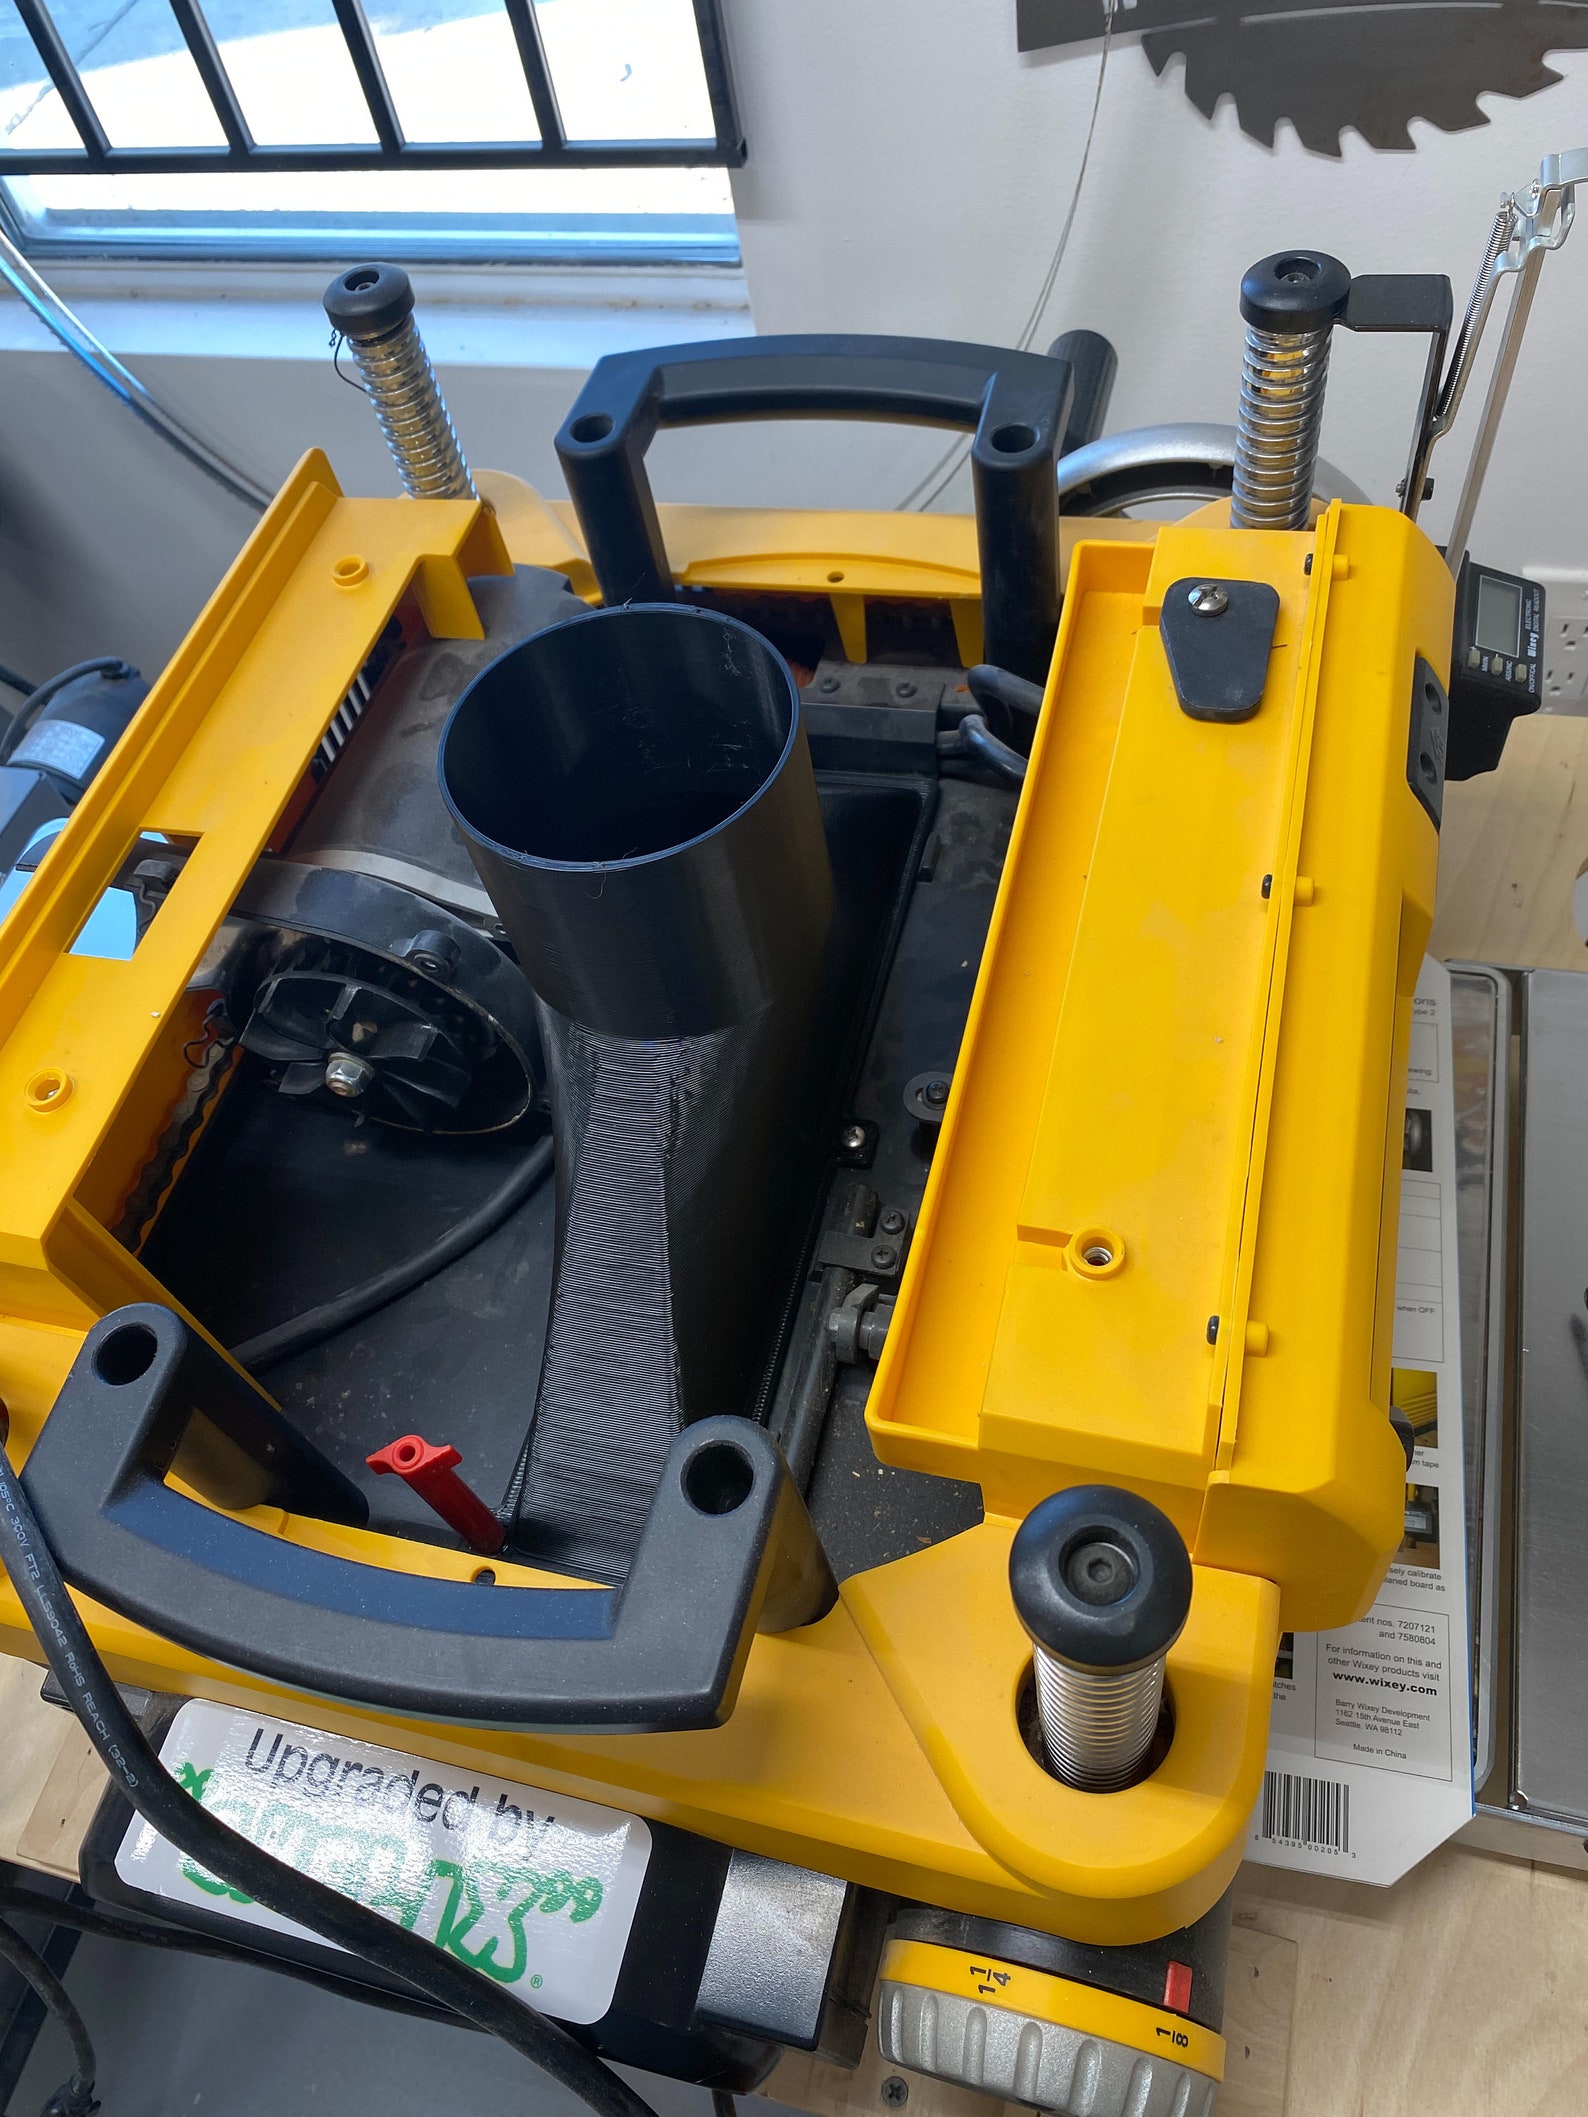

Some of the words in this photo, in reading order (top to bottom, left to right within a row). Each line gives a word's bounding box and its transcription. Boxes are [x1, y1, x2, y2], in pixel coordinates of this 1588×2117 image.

[1422, 1460, 1440, 1469] tape
[1407, 1569, 1442, 1581] calibrate
[1410, 1580, 1434, 1590] board
[1398, 1620, 1436, 1633] 7207121
[1379, 1631, 1396, 1640] and
[1398, 1632, 1436, 1645] 7580804
[25, 1553, 41, 1581] FT2
[64, 1651, 86, 1687] RoHS
[82, 1691, 110, 1741] REACH
[1325, 1643, 1340, 1653] For
[1342, 1646, 1391, 1661] information
[1393, 1655, 1405, 1663] on
[1407, 1656, 1423, 1666] this
[1425, 1660, 1442, 1670] and
[1328, 1656, 1351, 1667] other
[1352, 1659, 1380, 1673] Wixey
[1382, 1665, 1420, 1678] products
[1422, 1672, 1440, 1681] visit
[1332, 1671, 1438, 1696] www.wixey.com
[1335, 1698, 1355, 1709] Barry
[1356, 1702, 1380, 1714] Wixey
[1381, 1706, 1431, 1721] Development
[1355, 1711, 1372, 1721] 15th
[1372, 1715, 1401, 1726] Avenue
[1403, 1720, 1420, 1729] East
[1365, 1723, 1379, 1733] WA
[1379, 1726, 1403, 1736] 98112
[1353, 1743, 1375, 1754] Made
[1384, 1749, 1407, 1759] China
[243, 1728, 480, 1833] Upgraded
[496, 1794, 557, 1860] by
